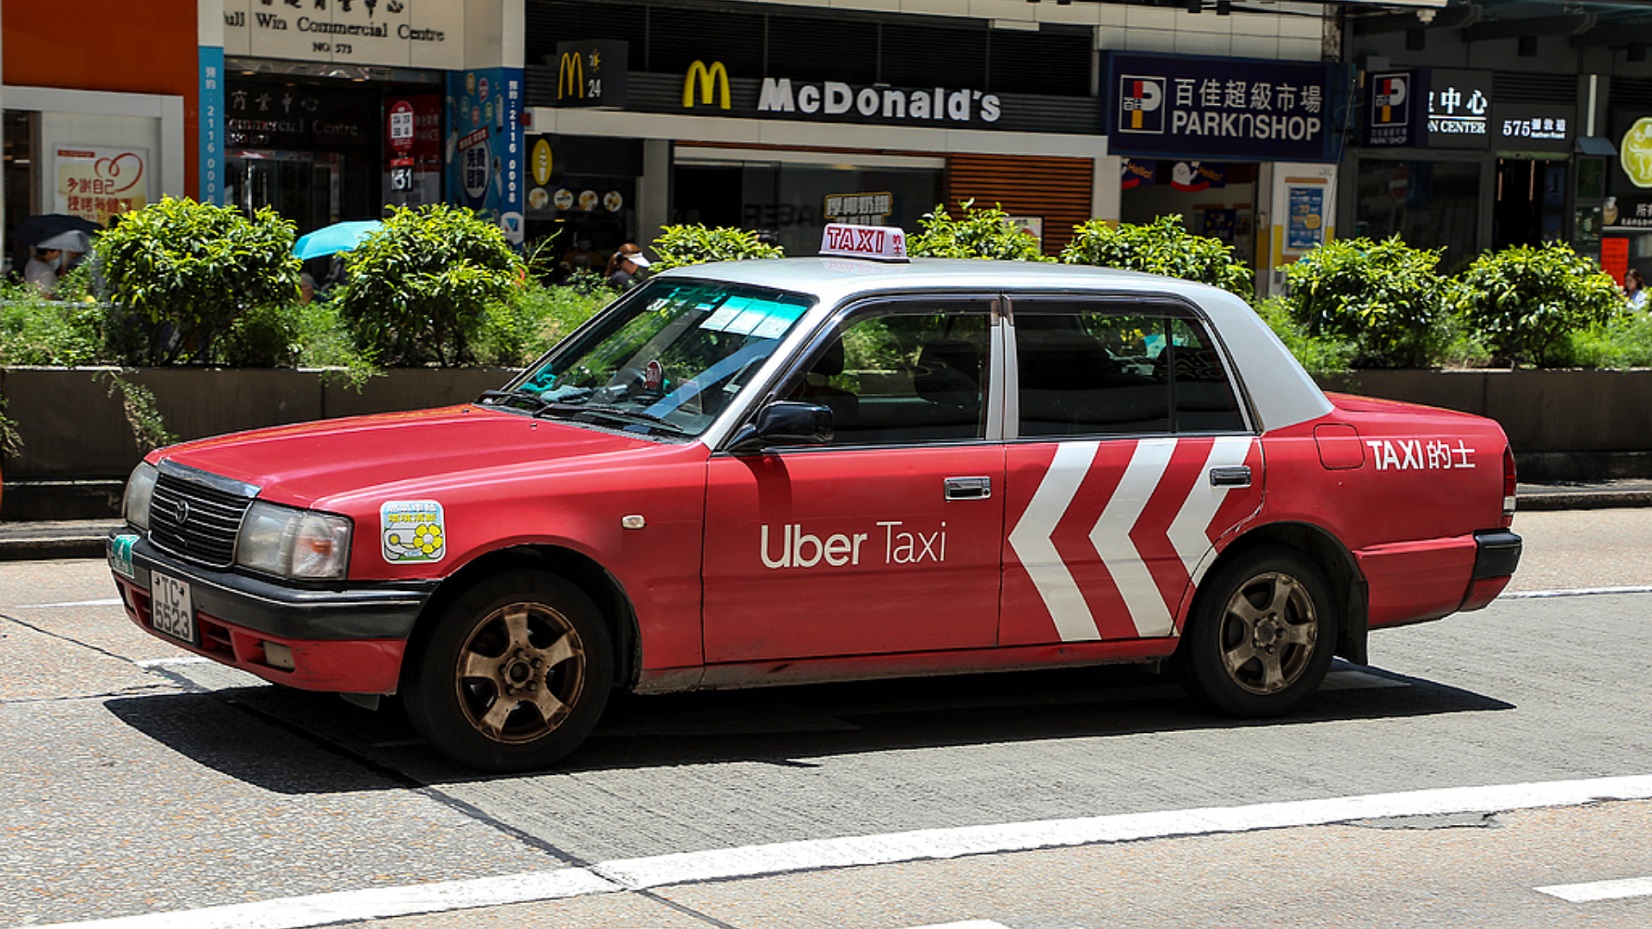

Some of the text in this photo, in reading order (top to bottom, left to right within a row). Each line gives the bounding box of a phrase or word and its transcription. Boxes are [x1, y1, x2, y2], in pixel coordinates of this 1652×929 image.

[224, 11, 444, 42] ull Win Commercial Centre
[335, 43, 353, 55] 573
[588, 79, 601, 98] 24
[757, 77, 1001, 122] McDonald's
[1174, 78, 1323, 113] 百佳超級市場
[1428, 86, 1488, 115] 中心
[1171, 110, 1322, 141] PARKnSHOP
[1440, 120, 1487, 134] CENTER
[1503, 120, 1531, 137] 575
[508, 159, 517, 203] 0008
[827, 226, 886, 254] TAXI
[892, 234, 901, 255] 的士
[1366, 439, 1476, 470] TAXI 的士
[760, 521, 947, 569] Uber Taxi
[161, 577, 179, 609] TC
[155, 600, 190, 638] 5523
